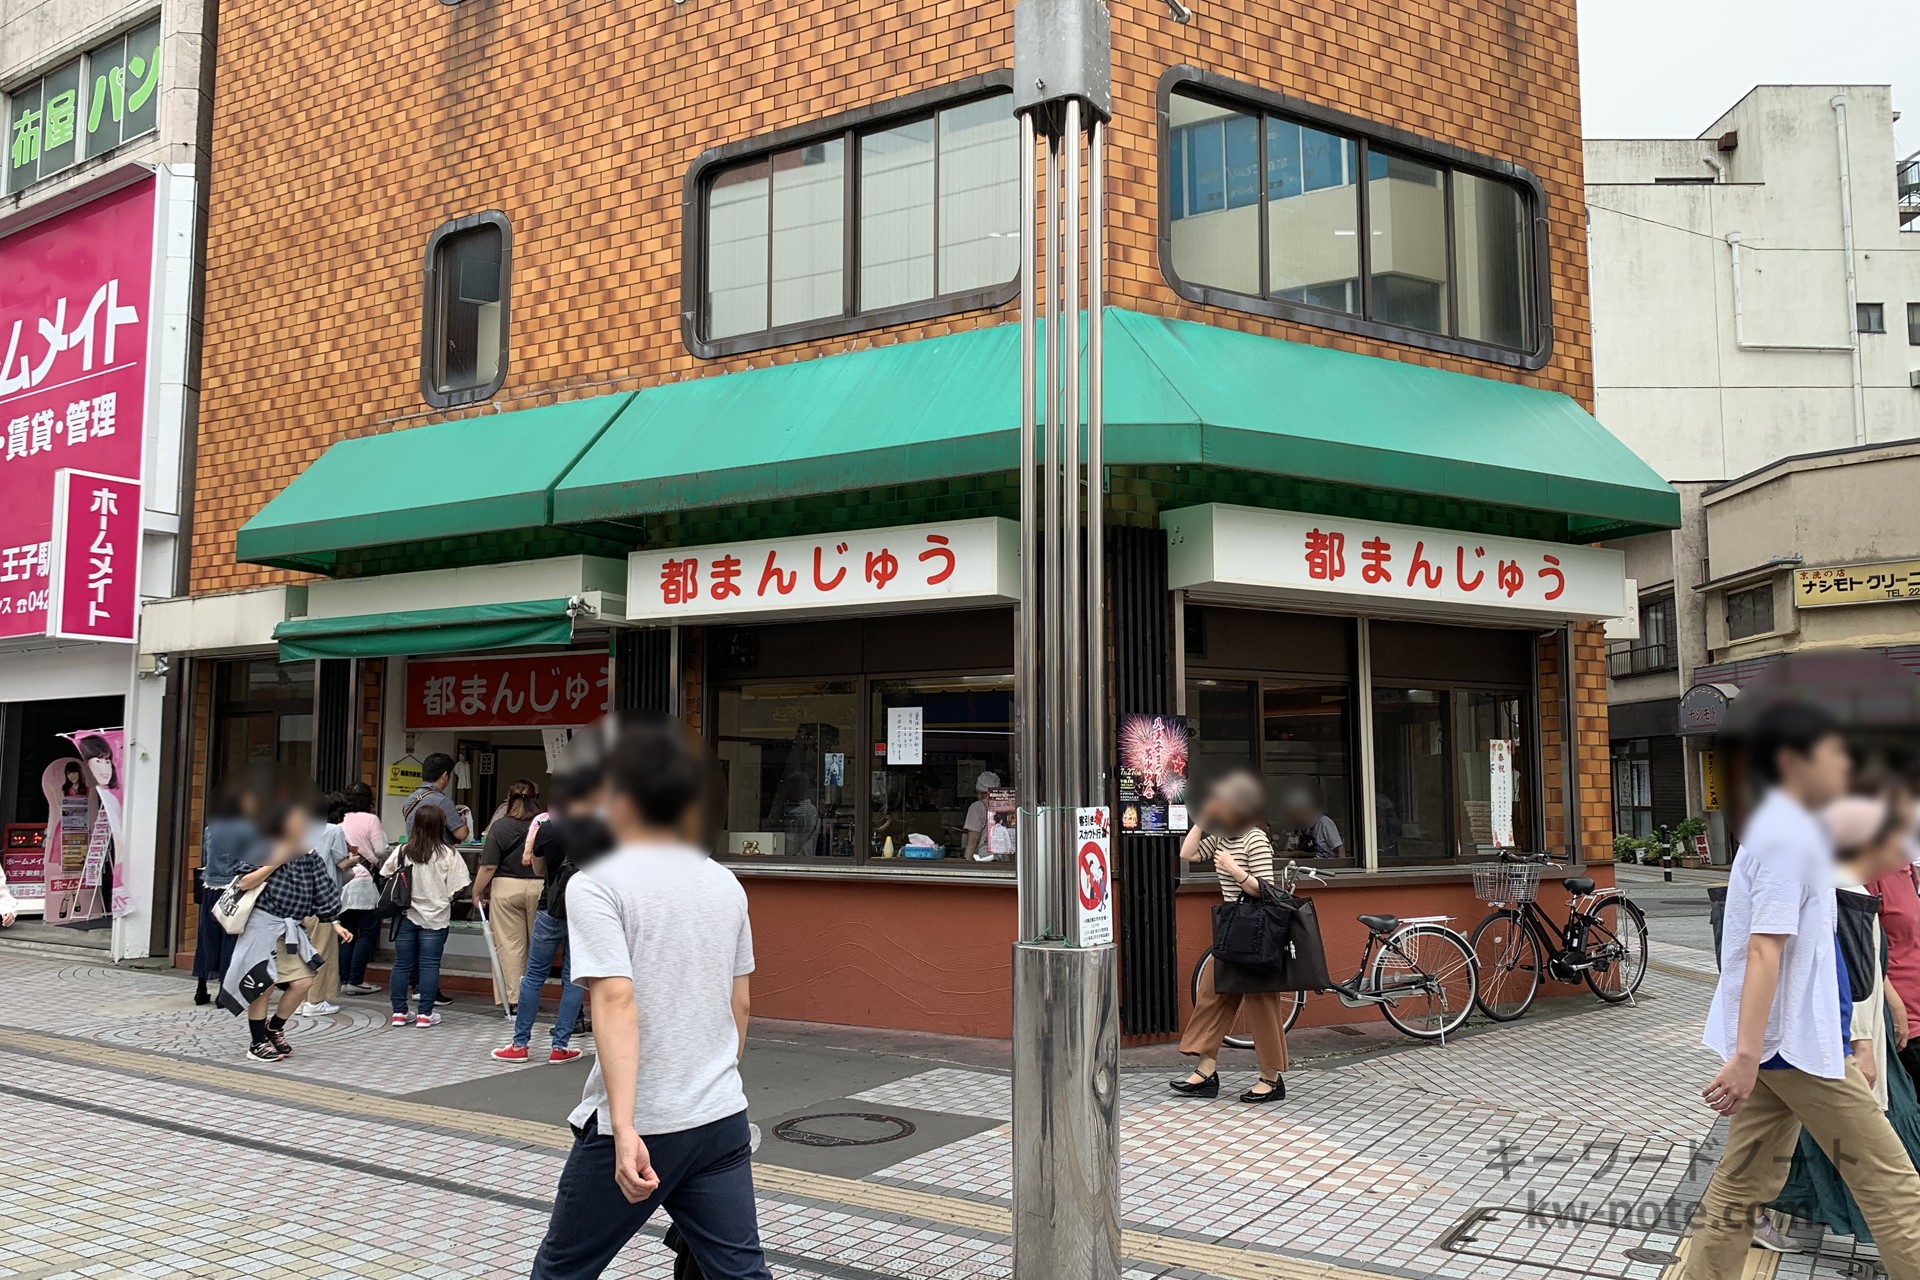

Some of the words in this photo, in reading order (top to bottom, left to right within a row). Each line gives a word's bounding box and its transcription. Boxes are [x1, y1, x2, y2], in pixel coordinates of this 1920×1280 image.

[88, 488, 118, 626] ホームメイト
[661, 534, 956, 604] 都まんじゅう
[1304, 528, 1566, 600] 都まんじゅう
[0, 597, 12, 614] ス
[1886, 589, 1904, 598] TEL
[1688, 706, 1717, 720] ナシモト
[1695, 831, 1711, 865] 車禁止
